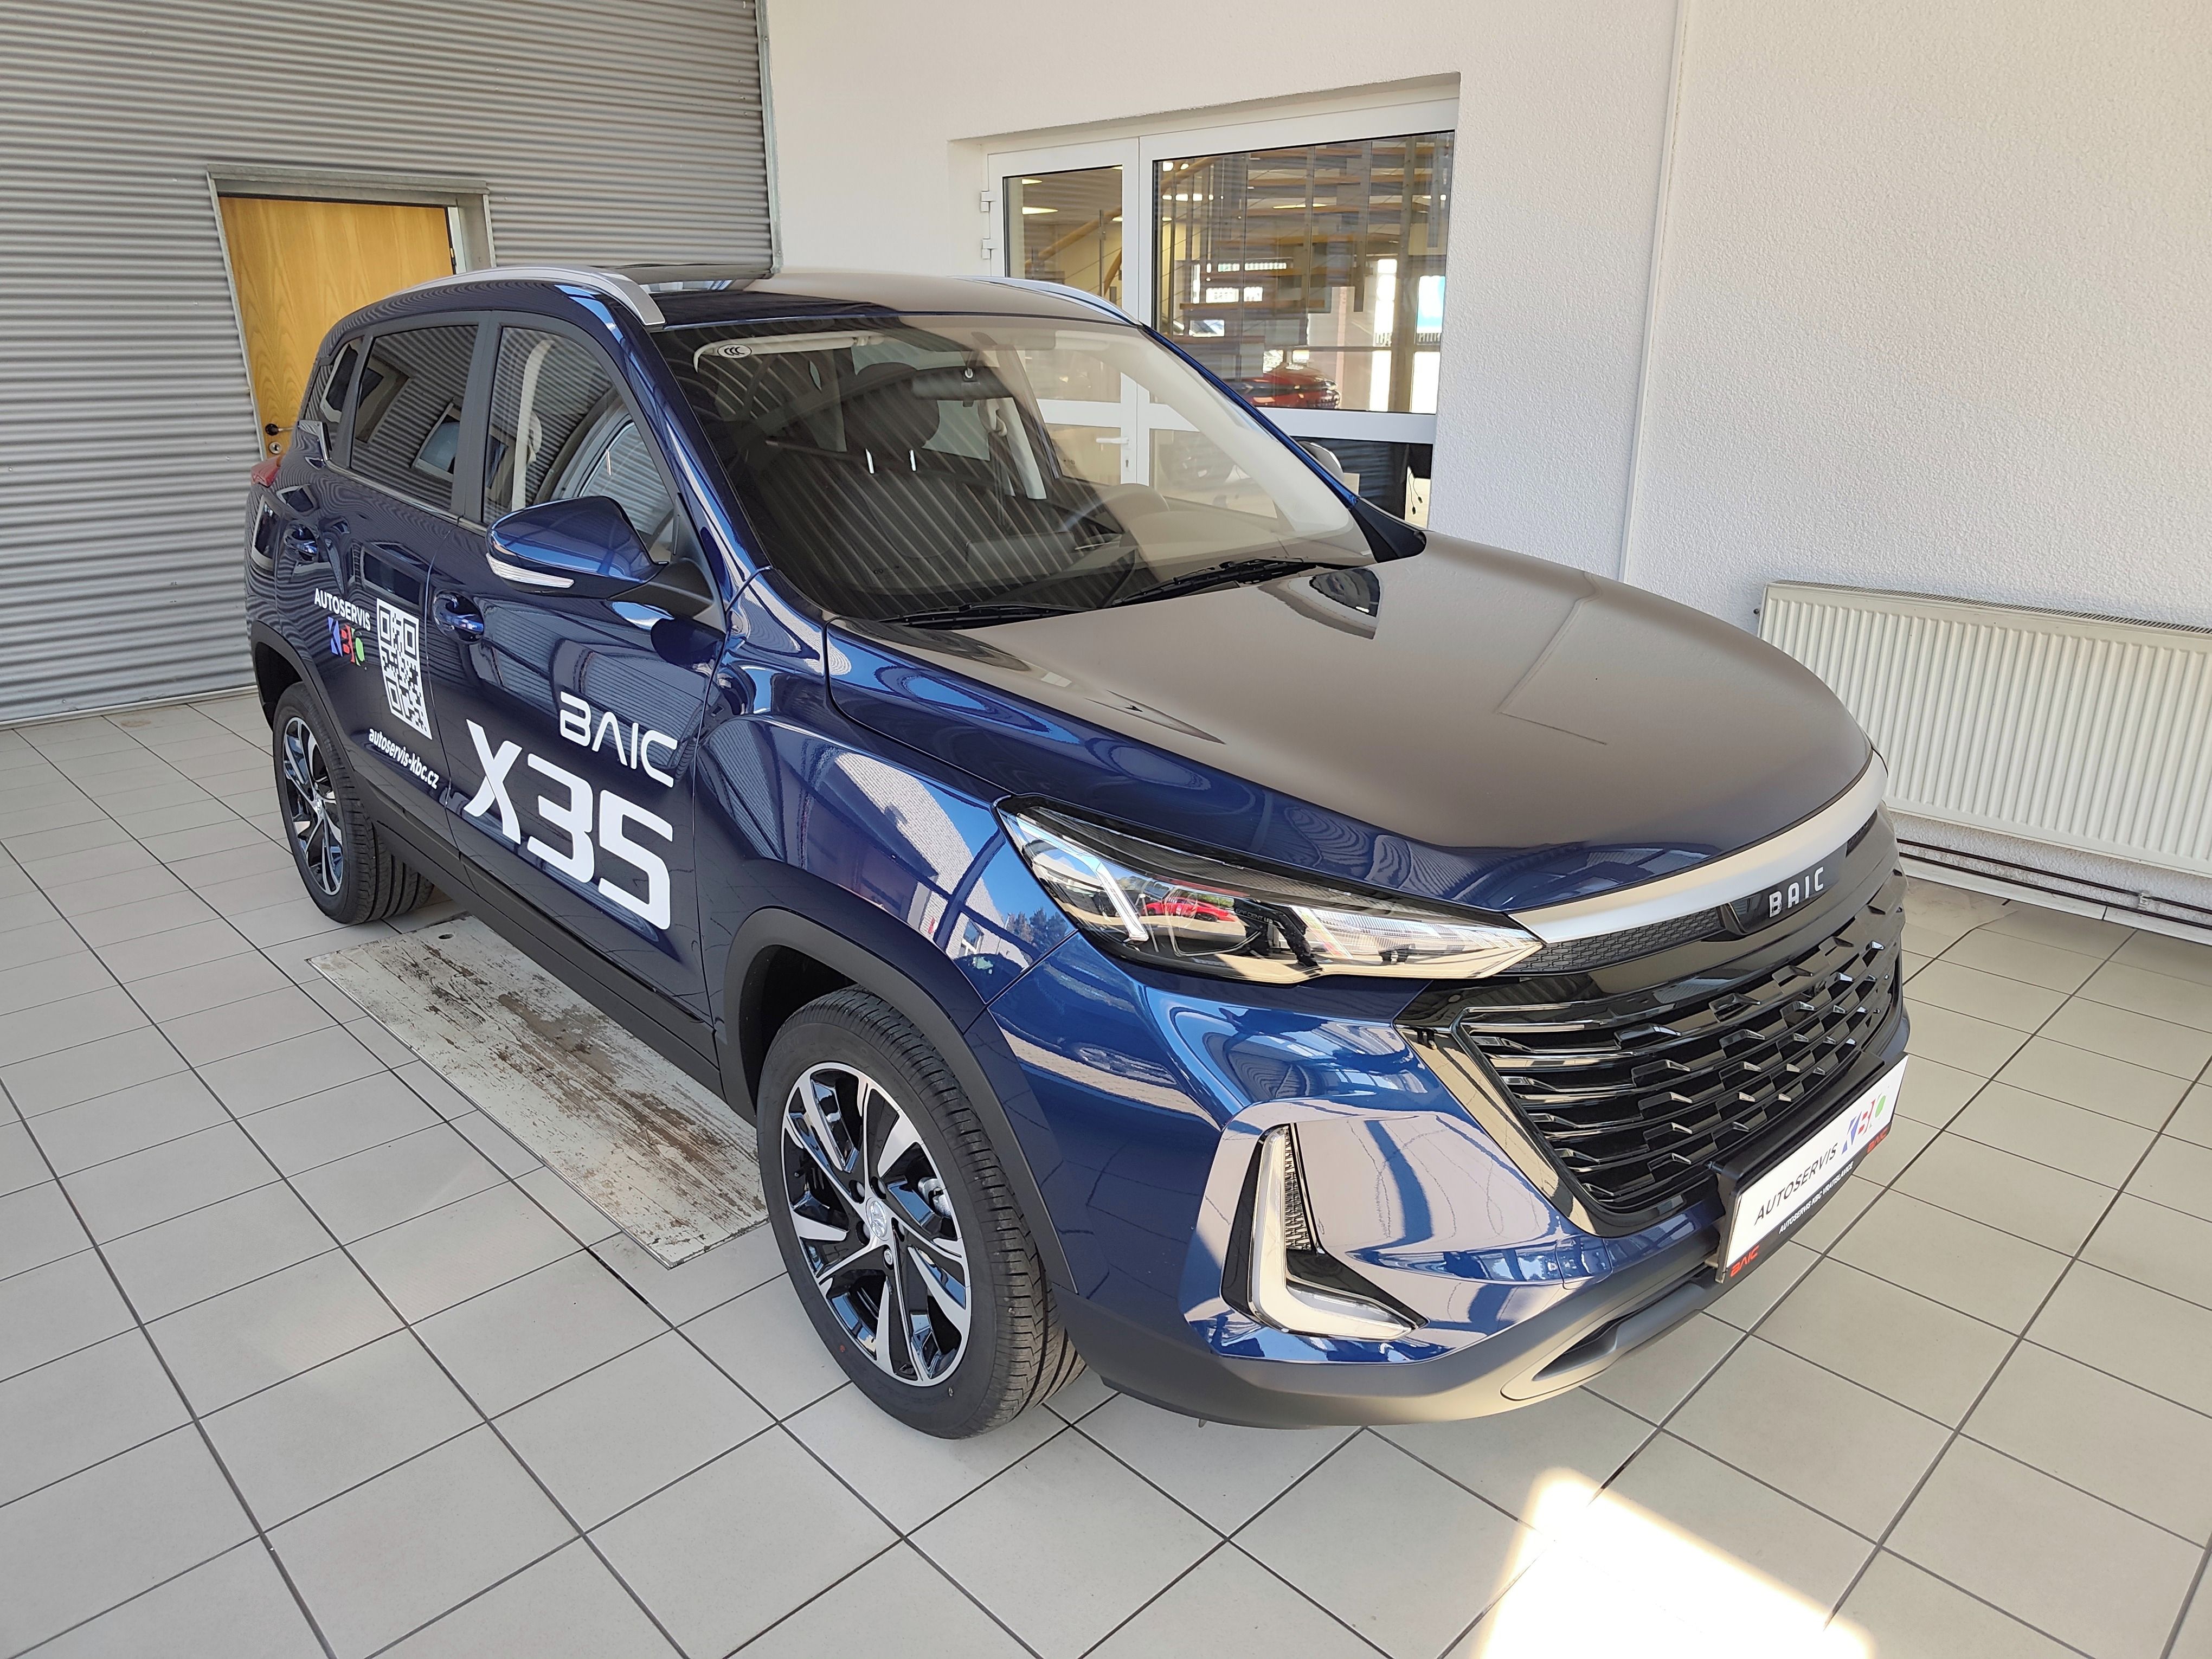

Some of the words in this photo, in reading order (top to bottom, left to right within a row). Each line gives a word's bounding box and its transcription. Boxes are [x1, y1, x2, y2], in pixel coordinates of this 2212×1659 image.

[314, 588, 371, 631] AUTOSERVIS
[369, 728, 440, 789] autoservis-kbc.cz
[560, 691, 678, 788] BAIC
[463, 718, 673, 930] X35
[1769, 866, 1824, 918] BAIC
[1730, 1245, 1760, 1277] BAIC
[1779, 1200, 1812, 1234] AUTOSERVIS
[1811, 1191, 1823, 1206] KBC
[1823, 1161, 1854, 1195] VRATISLAVICE
[1754, 1142, 1838, 1226] AUTOSERVIS
